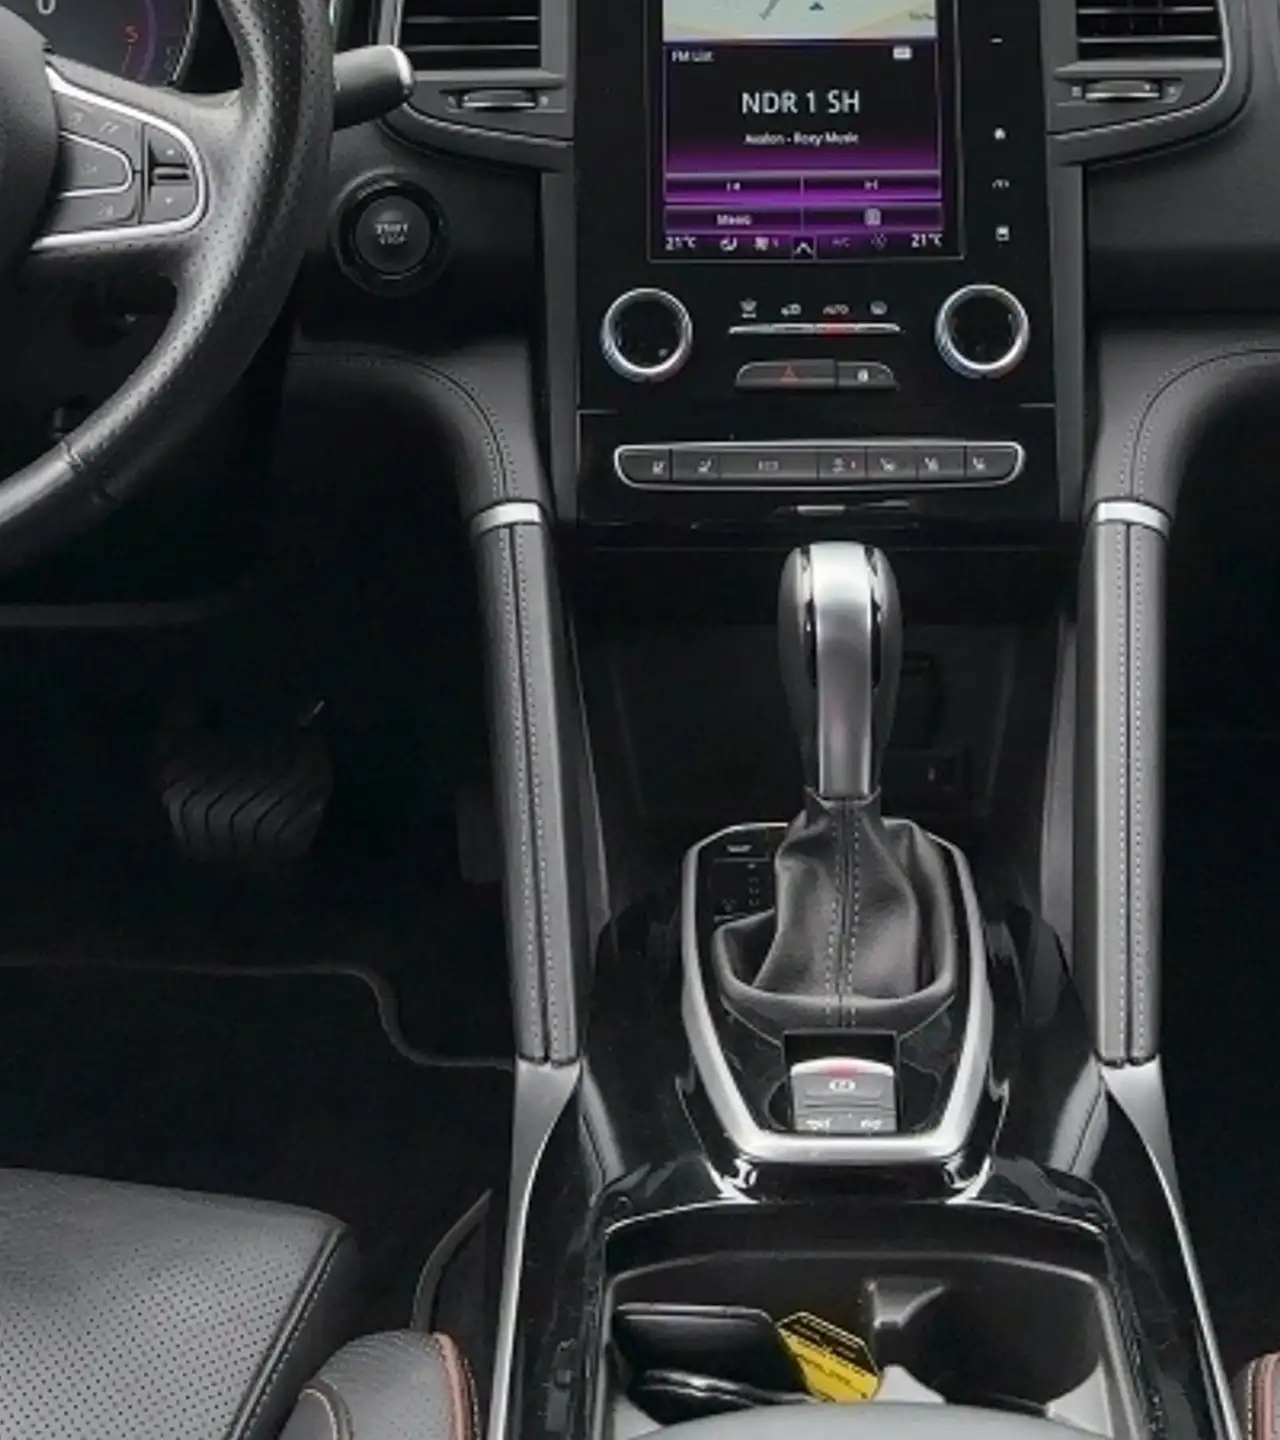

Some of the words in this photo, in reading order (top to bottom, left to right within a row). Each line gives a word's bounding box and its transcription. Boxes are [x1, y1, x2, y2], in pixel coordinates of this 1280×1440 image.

[124, 25, 139, 43] 5
[741, 91, 799, 114] NDR
[806, 90, 816, 113] 1
[826, 89, 860, 114] SH
[743, 132, 785, 146] Avalon
[793, 131, 824, 148] Roxy
[825, 131, 859, 145] Music
[665, 236, 697, 251] 21°C
[910, 233, 944, 248] 21°C
